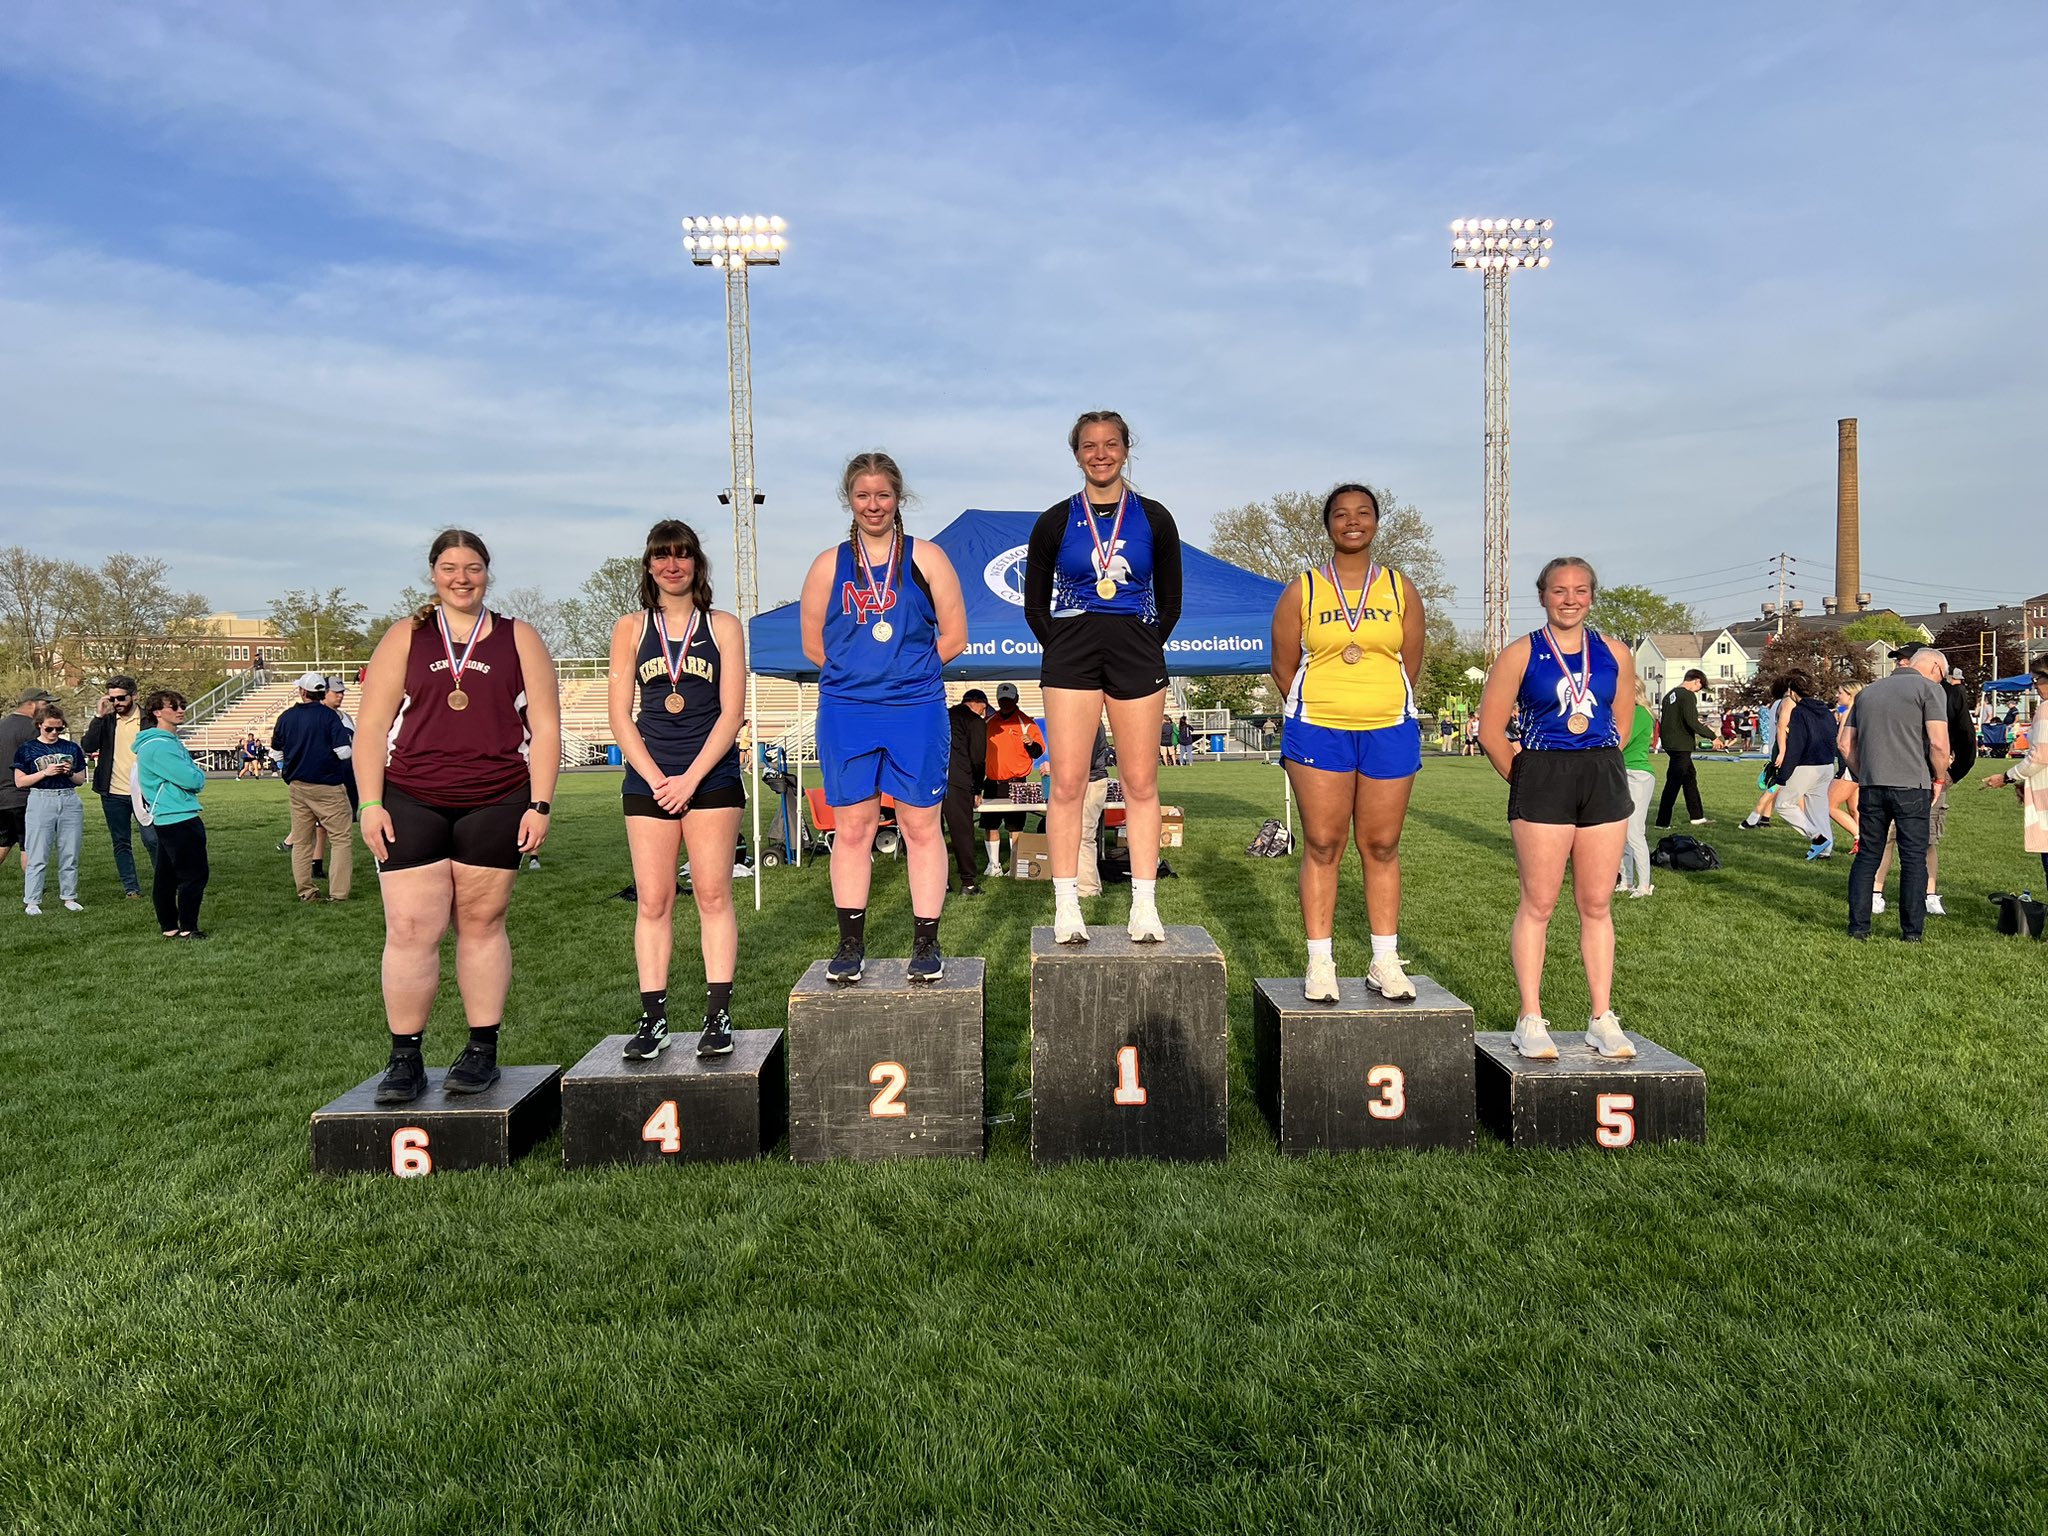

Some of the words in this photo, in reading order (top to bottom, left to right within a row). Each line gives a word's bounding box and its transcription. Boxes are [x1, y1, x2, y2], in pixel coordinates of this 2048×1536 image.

[429, 659, 491, 674] CENIONS
[639, 656, 669, 684] KISK
[869, 1061, 908, 1118] 2
[1114, 1046, 1147, 1105] 1
[1367, 1064, 1406, 1120] 3
[642, 1100, 681, 1153] 4
[1596, 1093, 1636, 1149] 5
[390, 1126, 432, 1178] 6
